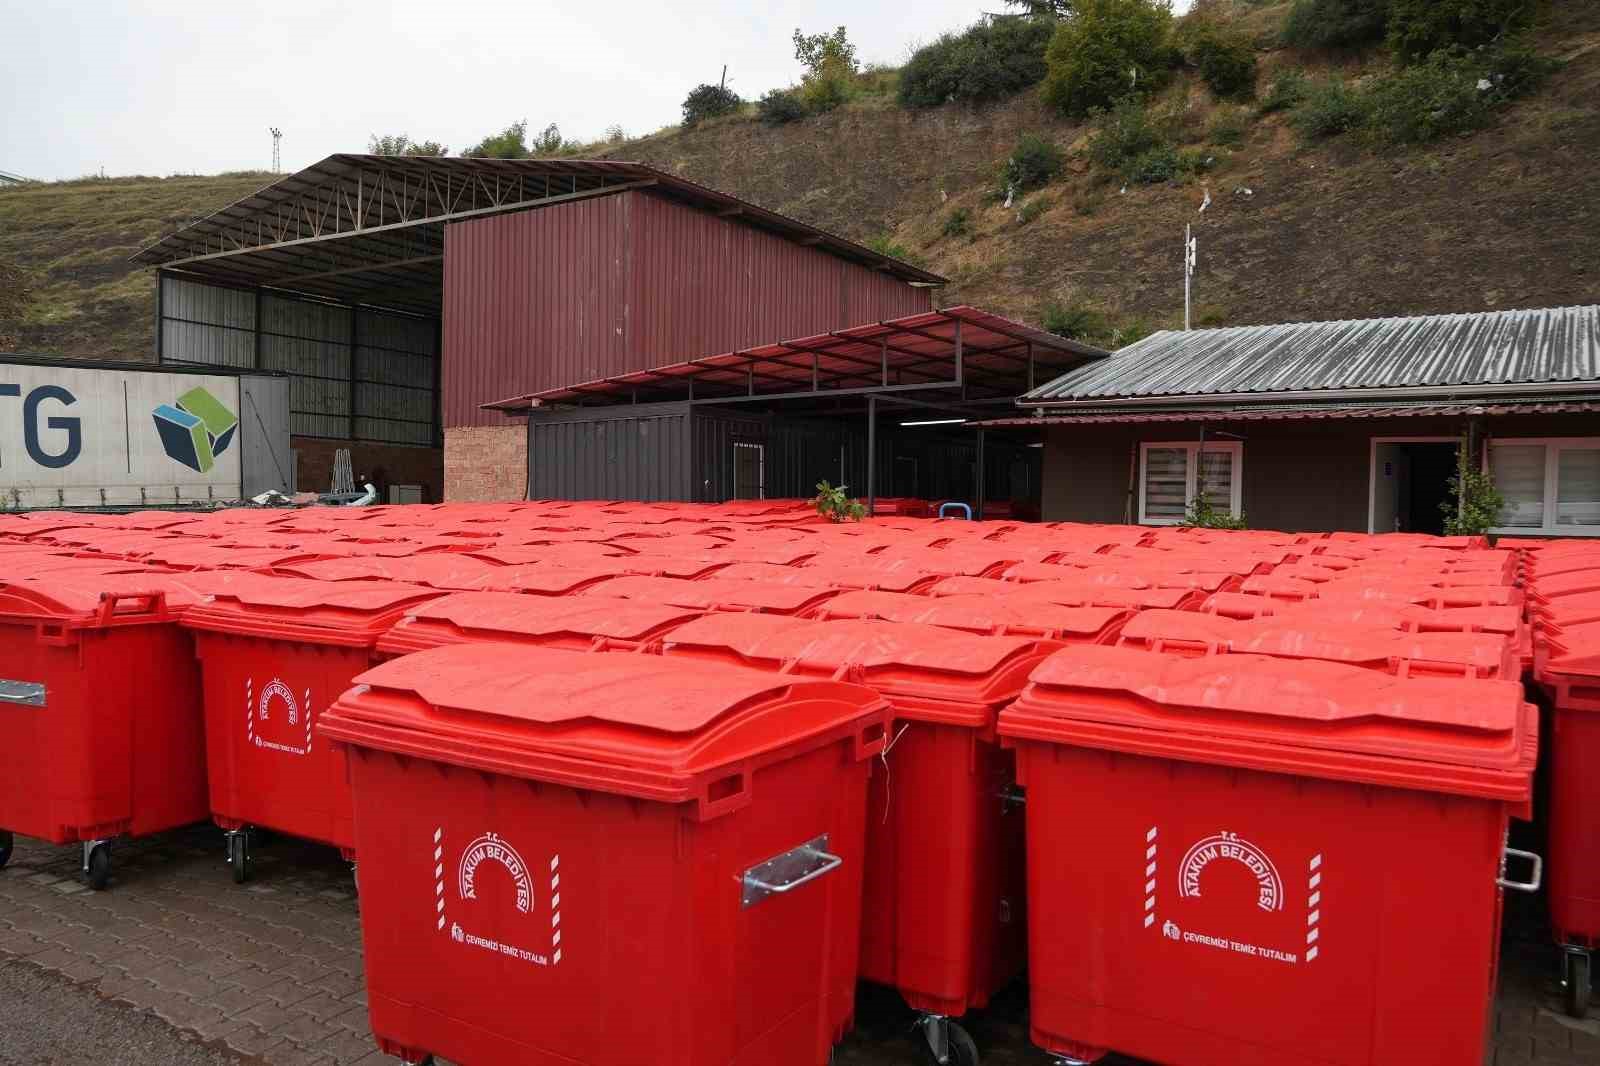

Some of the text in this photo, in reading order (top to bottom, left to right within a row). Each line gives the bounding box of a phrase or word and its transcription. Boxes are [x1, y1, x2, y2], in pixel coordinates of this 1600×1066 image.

[486, 831, 501, 843] T.C.
[1220, 830, 1241, 842] T.C.
[464, 847, 486, 899] ATAKUM
[1186, 846, 1218, 897] ATAKUM
[499, 943, 518, 958] TEMİZ
[519, 950, 547, 966] TUTALIM
[1183, 931, 1297, 963] ÇEVREMİZİ TEMİZ TUTALIM
